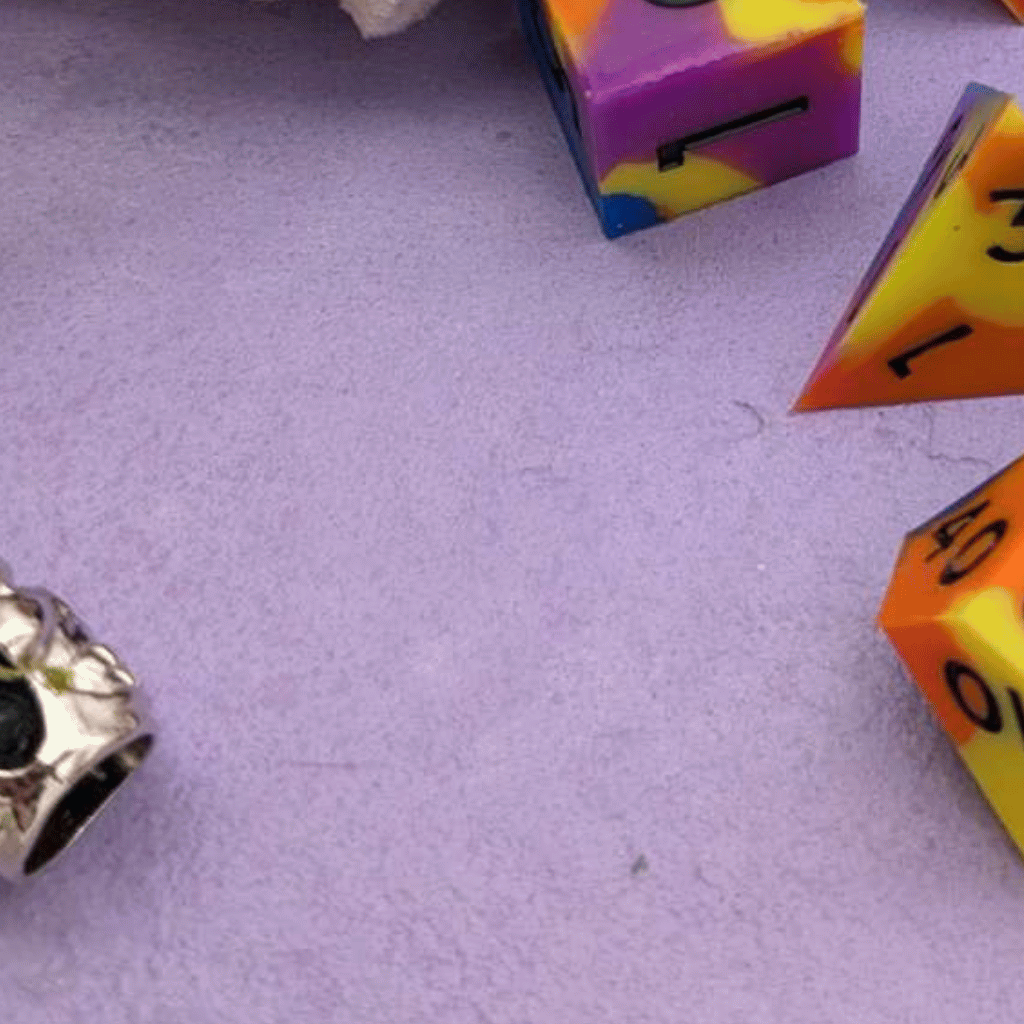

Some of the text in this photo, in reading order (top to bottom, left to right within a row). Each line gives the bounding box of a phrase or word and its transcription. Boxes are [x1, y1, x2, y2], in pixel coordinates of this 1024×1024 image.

[656, 95, 809, 172] 1
[887, 324, 974, 380] 1
[923, 499, 1009, 587] 40
